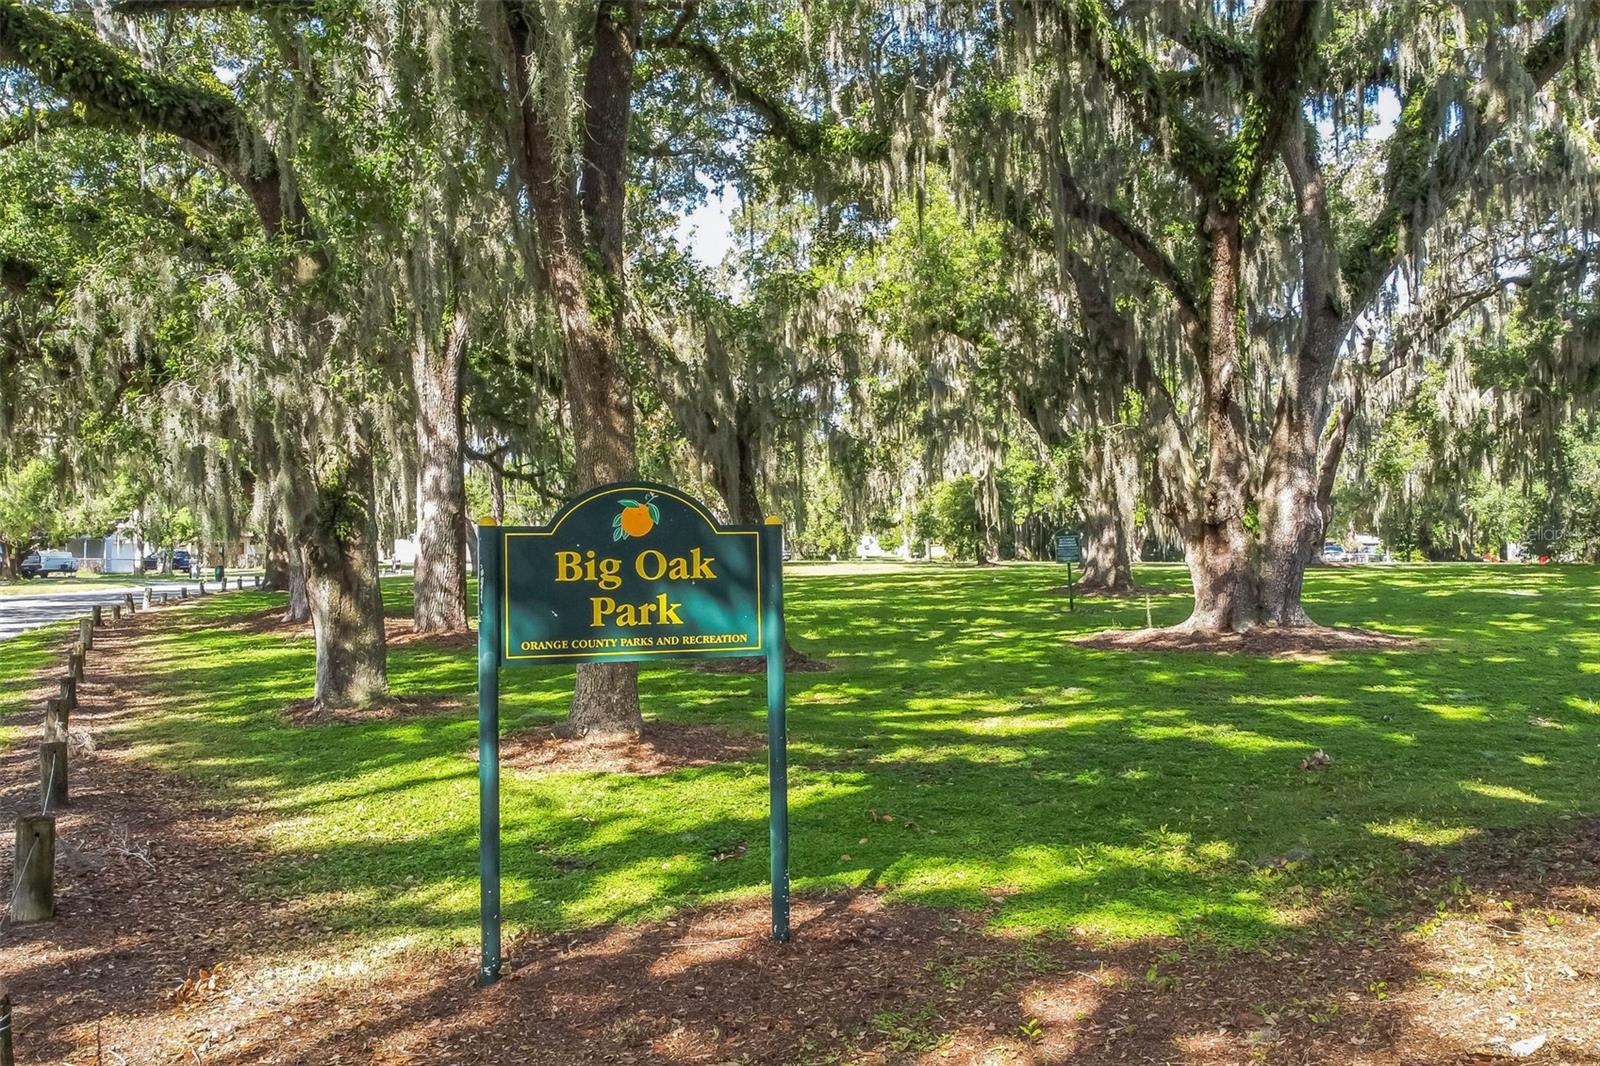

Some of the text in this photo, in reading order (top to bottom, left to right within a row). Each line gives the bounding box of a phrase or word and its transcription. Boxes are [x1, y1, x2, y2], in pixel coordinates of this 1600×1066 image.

[554, 547, 718, 590] Big Oak
[590, 592, 684, 627] Park
[521, 633, 748, 651] ORANGE COUNTY PARKS AND RECREATION
